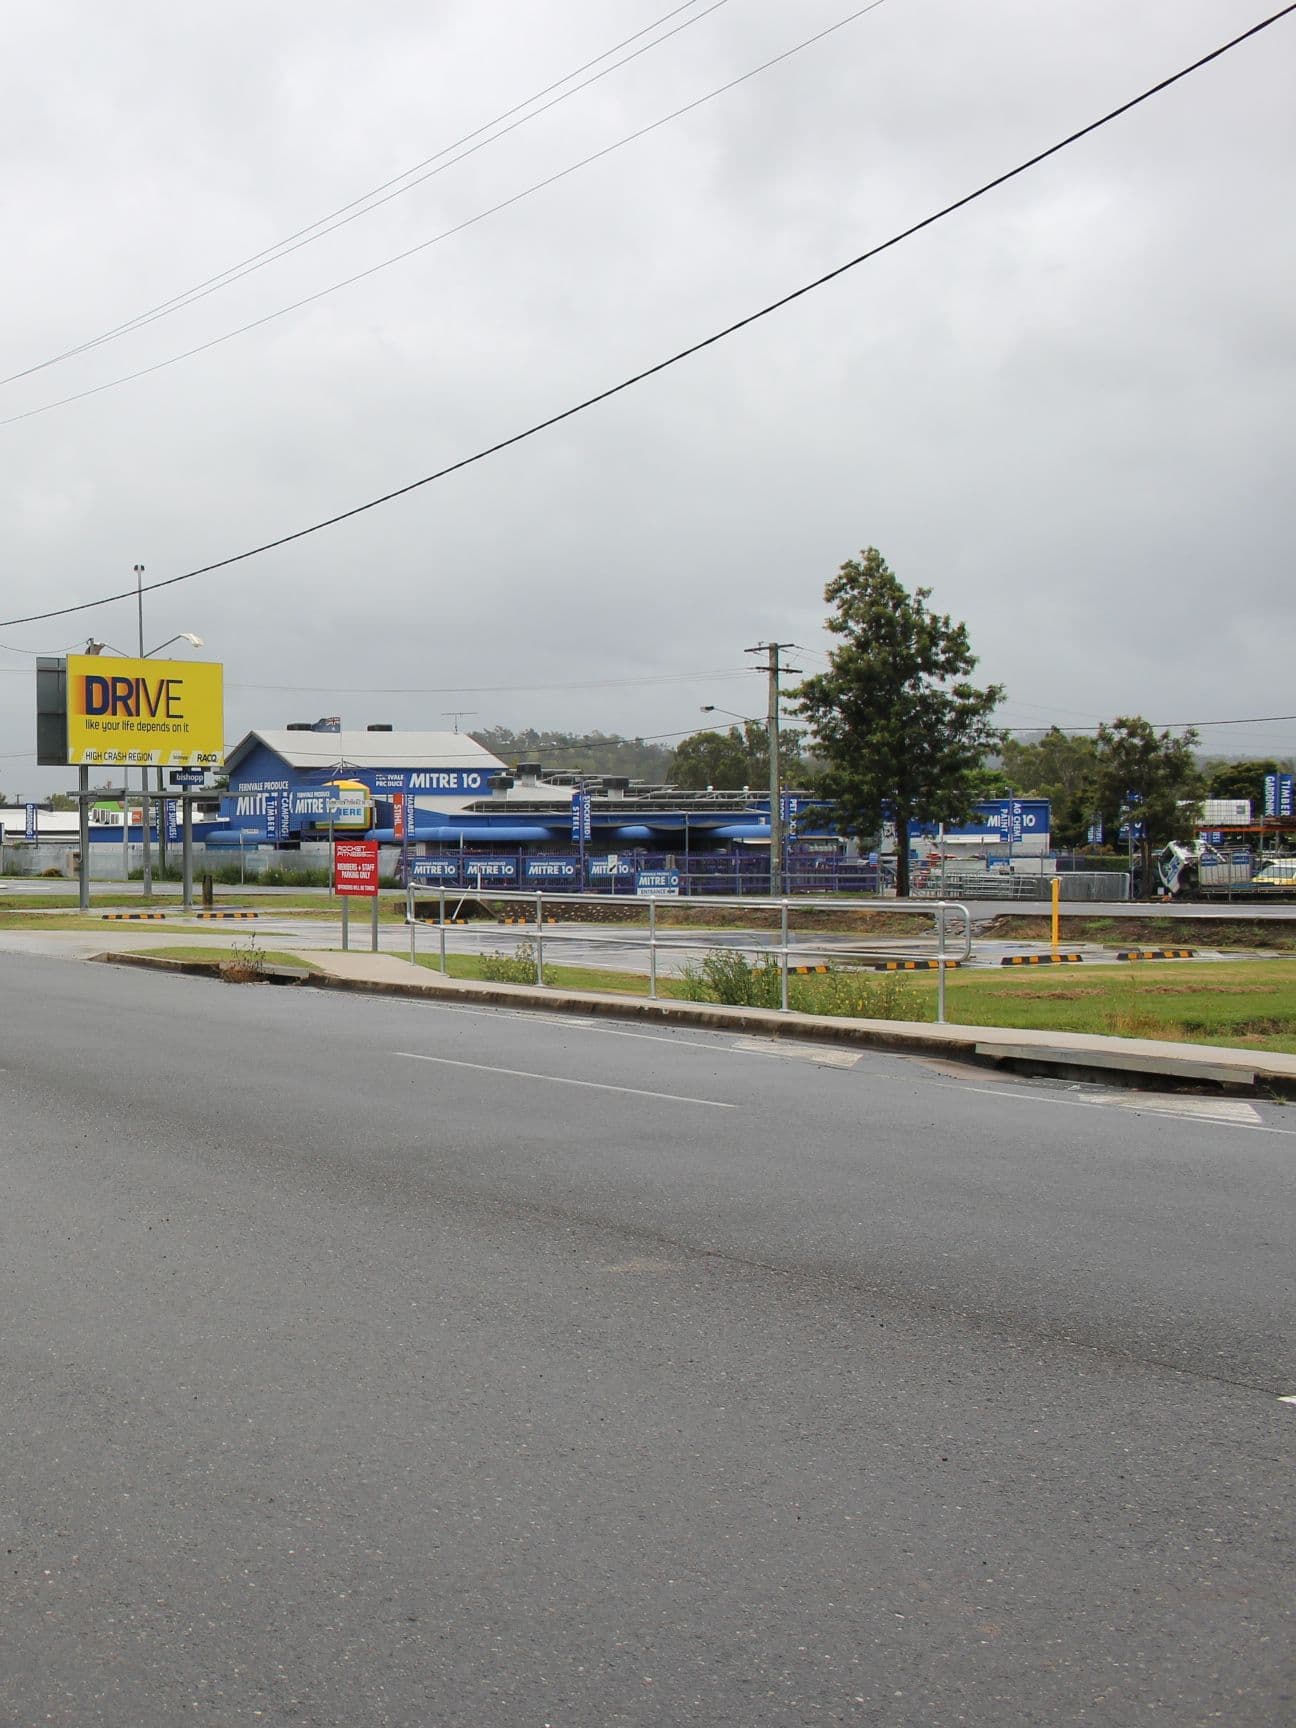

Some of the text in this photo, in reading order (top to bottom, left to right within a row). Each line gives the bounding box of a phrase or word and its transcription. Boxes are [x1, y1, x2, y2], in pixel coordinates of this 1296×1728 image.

[84, 675, 184, 719] DRIVE
[85, 719, 190, 733] like your life depends on it
[85, 751, 153, 762] HIGH CRASH REGION
[197, 754, 218, 763] RACQ
[176, 773, 204, 783] bishopp
[409, 773, 481, 789] MITRE 10
[239, 781, 289, 792] FERNVALE PRODUCE
[1280, 780, 1291, 816] TIMBER
[295, 799, 324, 813] MITRE
[267, 801, 275, 832] TIMBER
[281, 798, 289, 834] CAMPING
[394, 804, 402, 826] STIHL
[407, 794, 415, 833] HARDWARE
[572, 806, 580, 831] STEEL
[1000, 808, 1008, 832] PAINT
[1022, 815, 1036, 827] 10
[414, 866, 456, 874] MITRE 10
[501, 866, 514, 874] 10
[528, 866, 573, 874] MITRE 10
[618, 865, 629, 874] 10
[639, 877, 665, 885] MITRE
